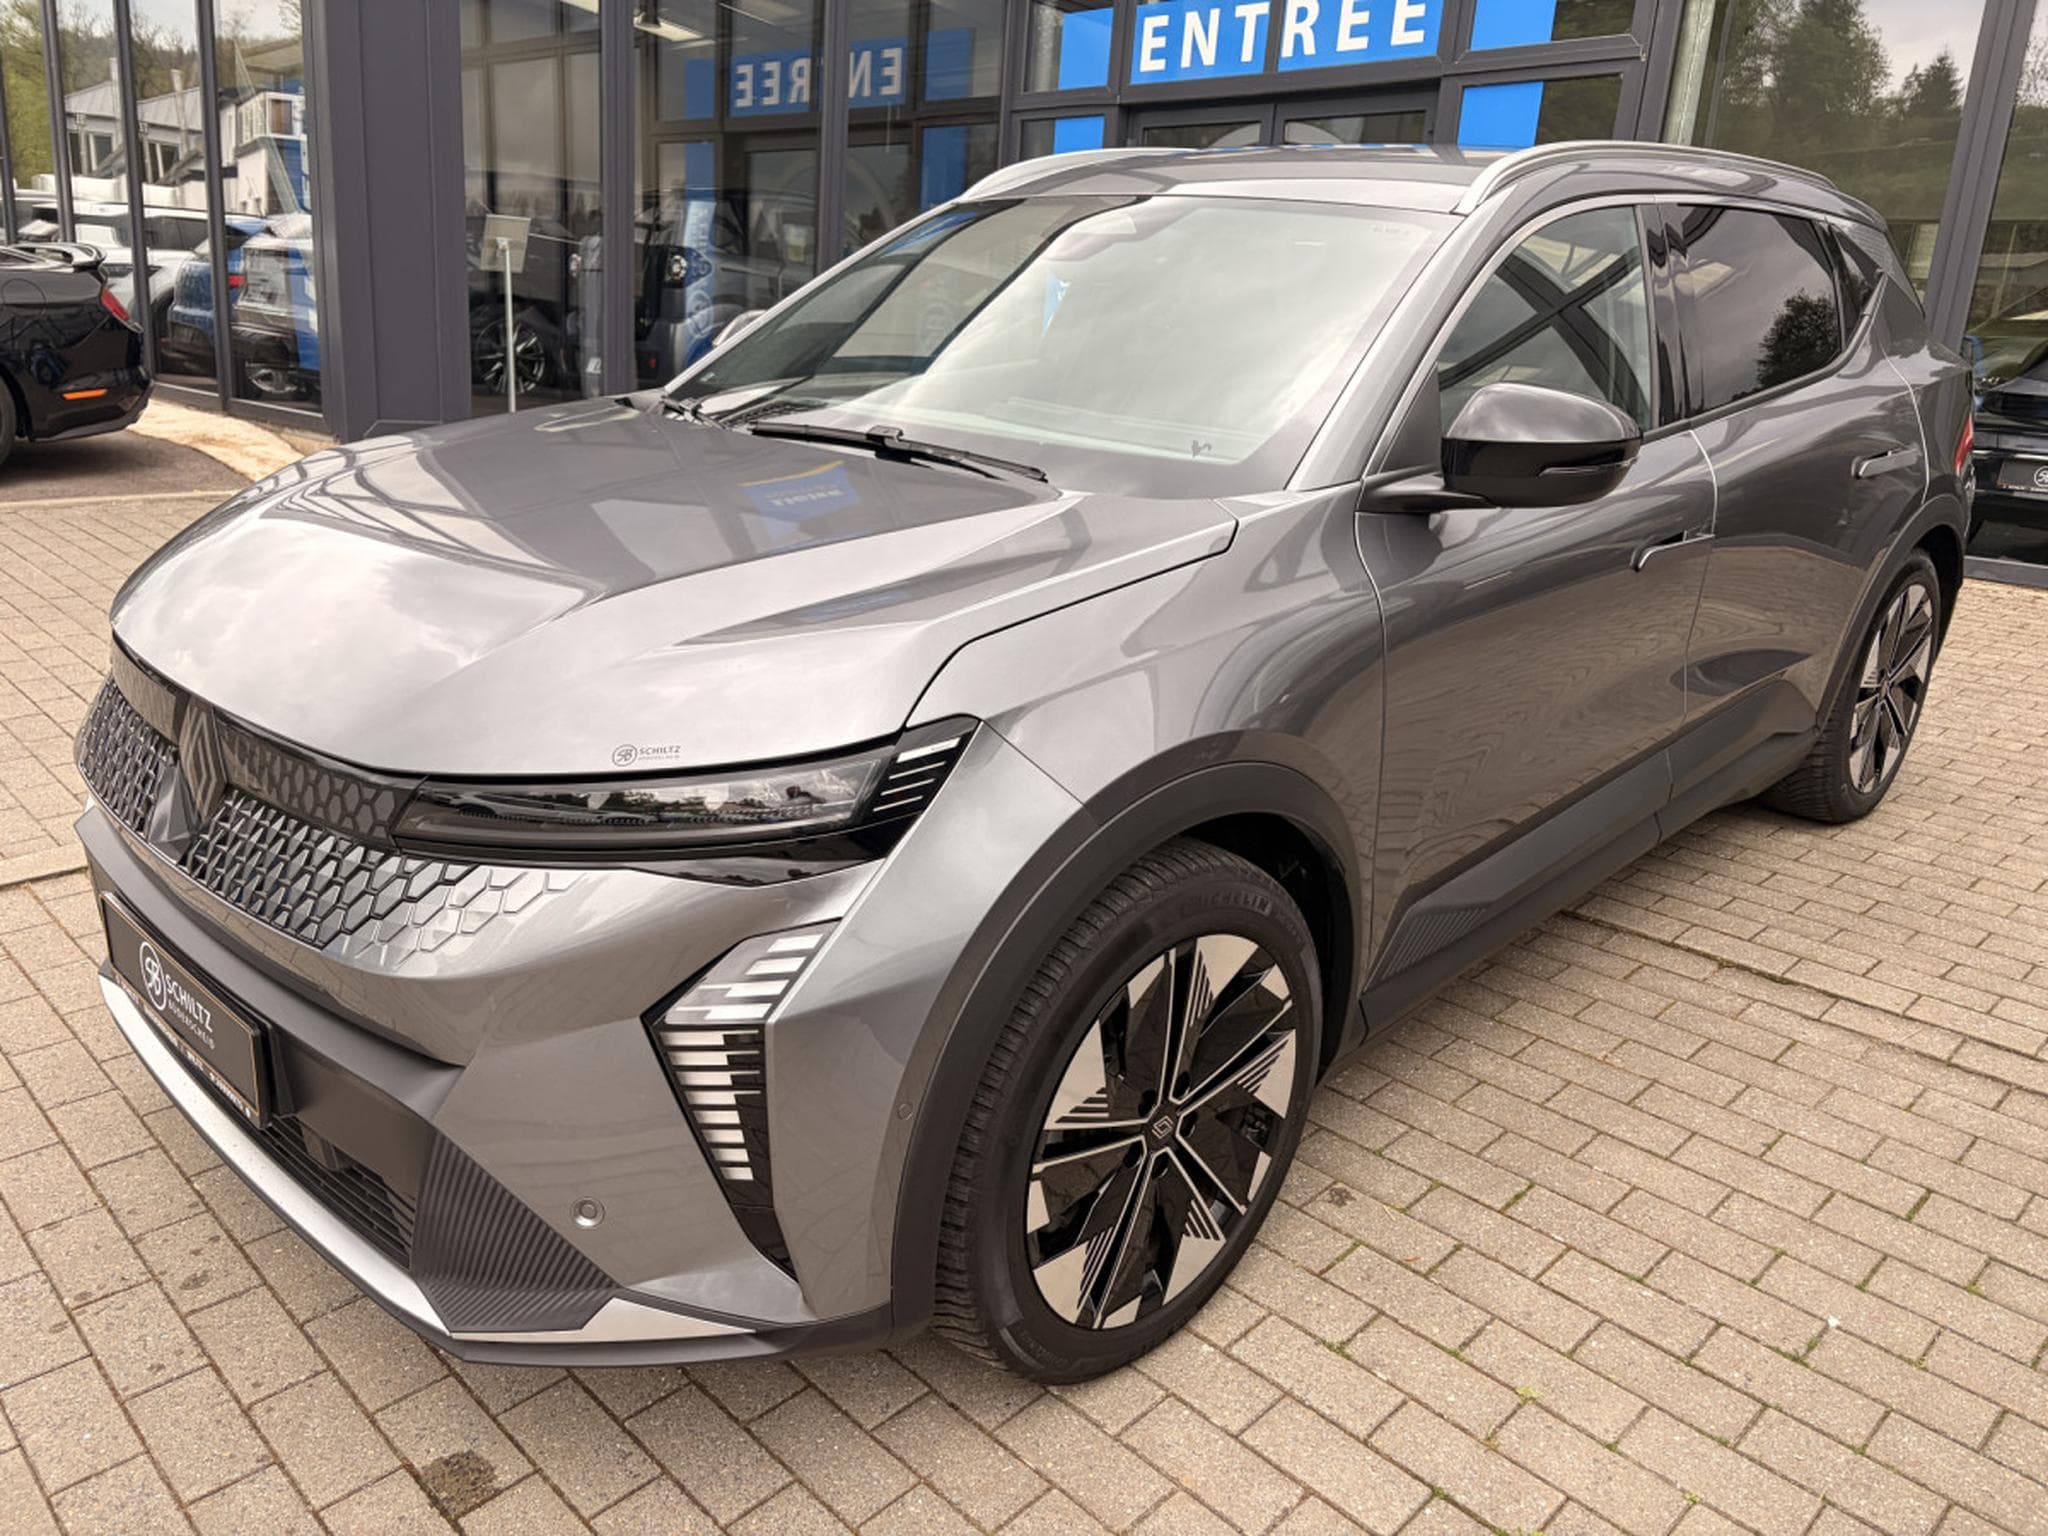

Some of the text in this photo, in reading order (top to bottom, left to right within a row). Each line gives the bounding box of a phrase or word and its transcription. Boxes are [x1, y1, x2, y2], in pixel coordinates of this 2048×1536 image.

[1139, 0, 1427, 73] ENTREE
[640, 745, 681, 755] SCHILTZ
[165, 974, 214, 1034] SCHILTZ
